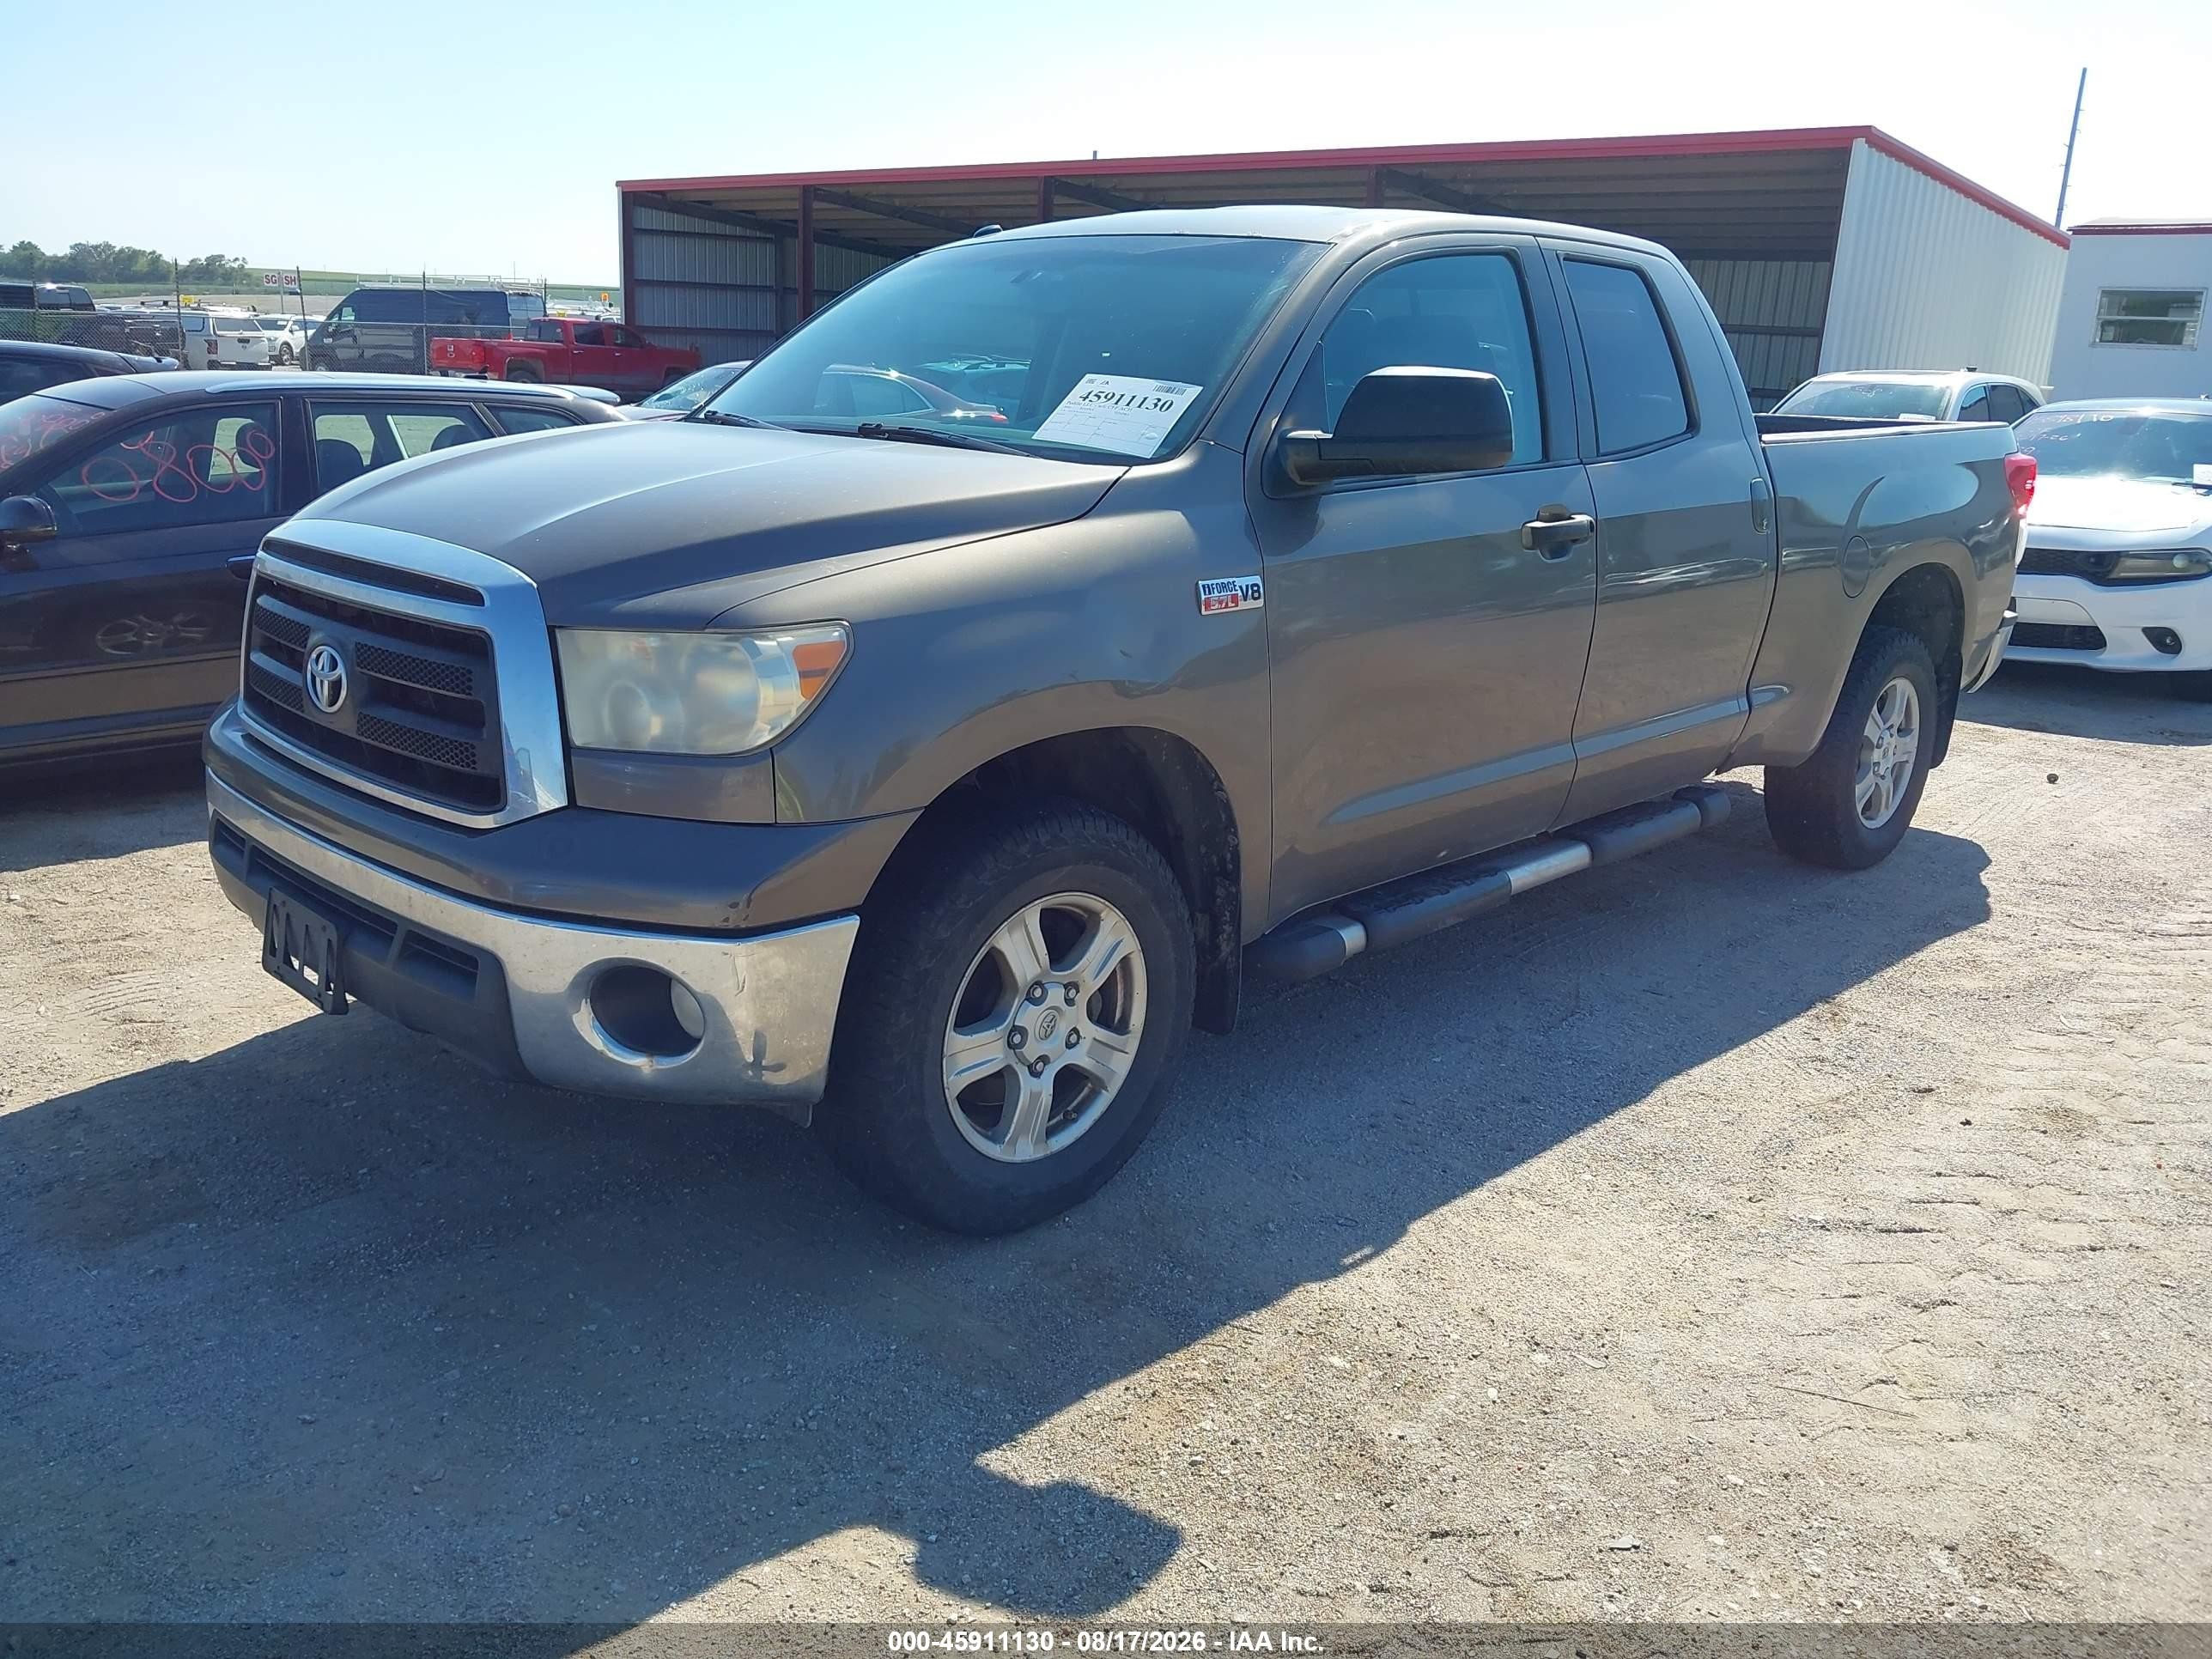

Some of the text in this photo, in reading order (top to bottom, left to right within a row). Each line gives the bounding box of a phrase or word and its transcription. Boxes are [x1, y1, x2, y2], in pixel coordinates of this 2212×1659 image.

[264, 274, 277, 284] SG
[284, 275, 296, 285] SH
[1079, 390, 1173, 412] 45911130
[1238, 583, 1261, 601] V8
